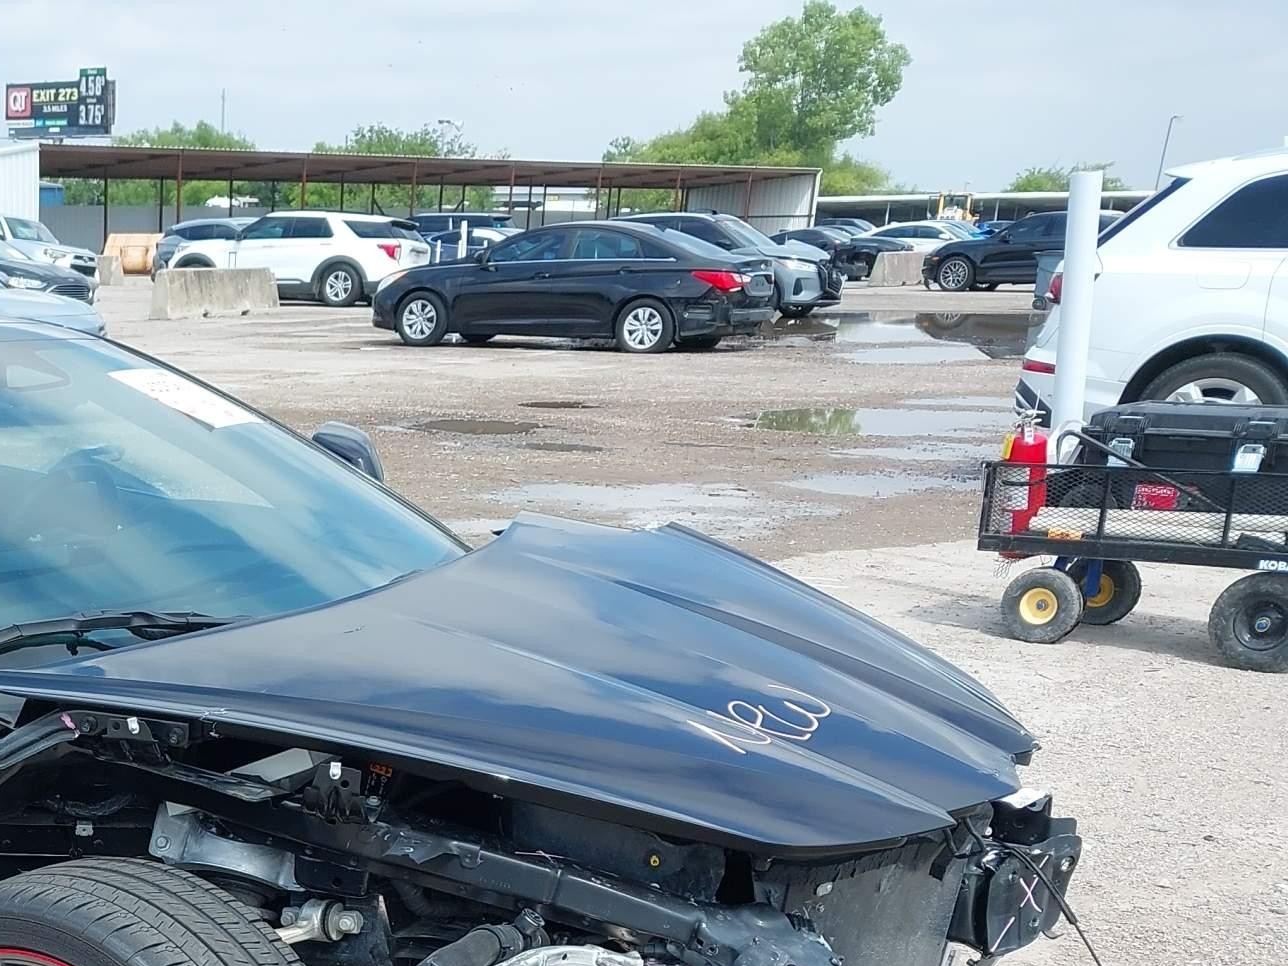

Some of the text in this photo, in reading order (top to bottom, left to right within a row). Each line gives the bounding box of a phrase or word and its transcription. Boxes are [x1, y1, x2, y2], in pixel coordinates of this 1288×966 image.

[9, 91, 27, 112] QT
[32, 88, 55, 102] EXIT
[57, 87, 79, 101] 273
[1258, 559, 1288, 571] KOB
